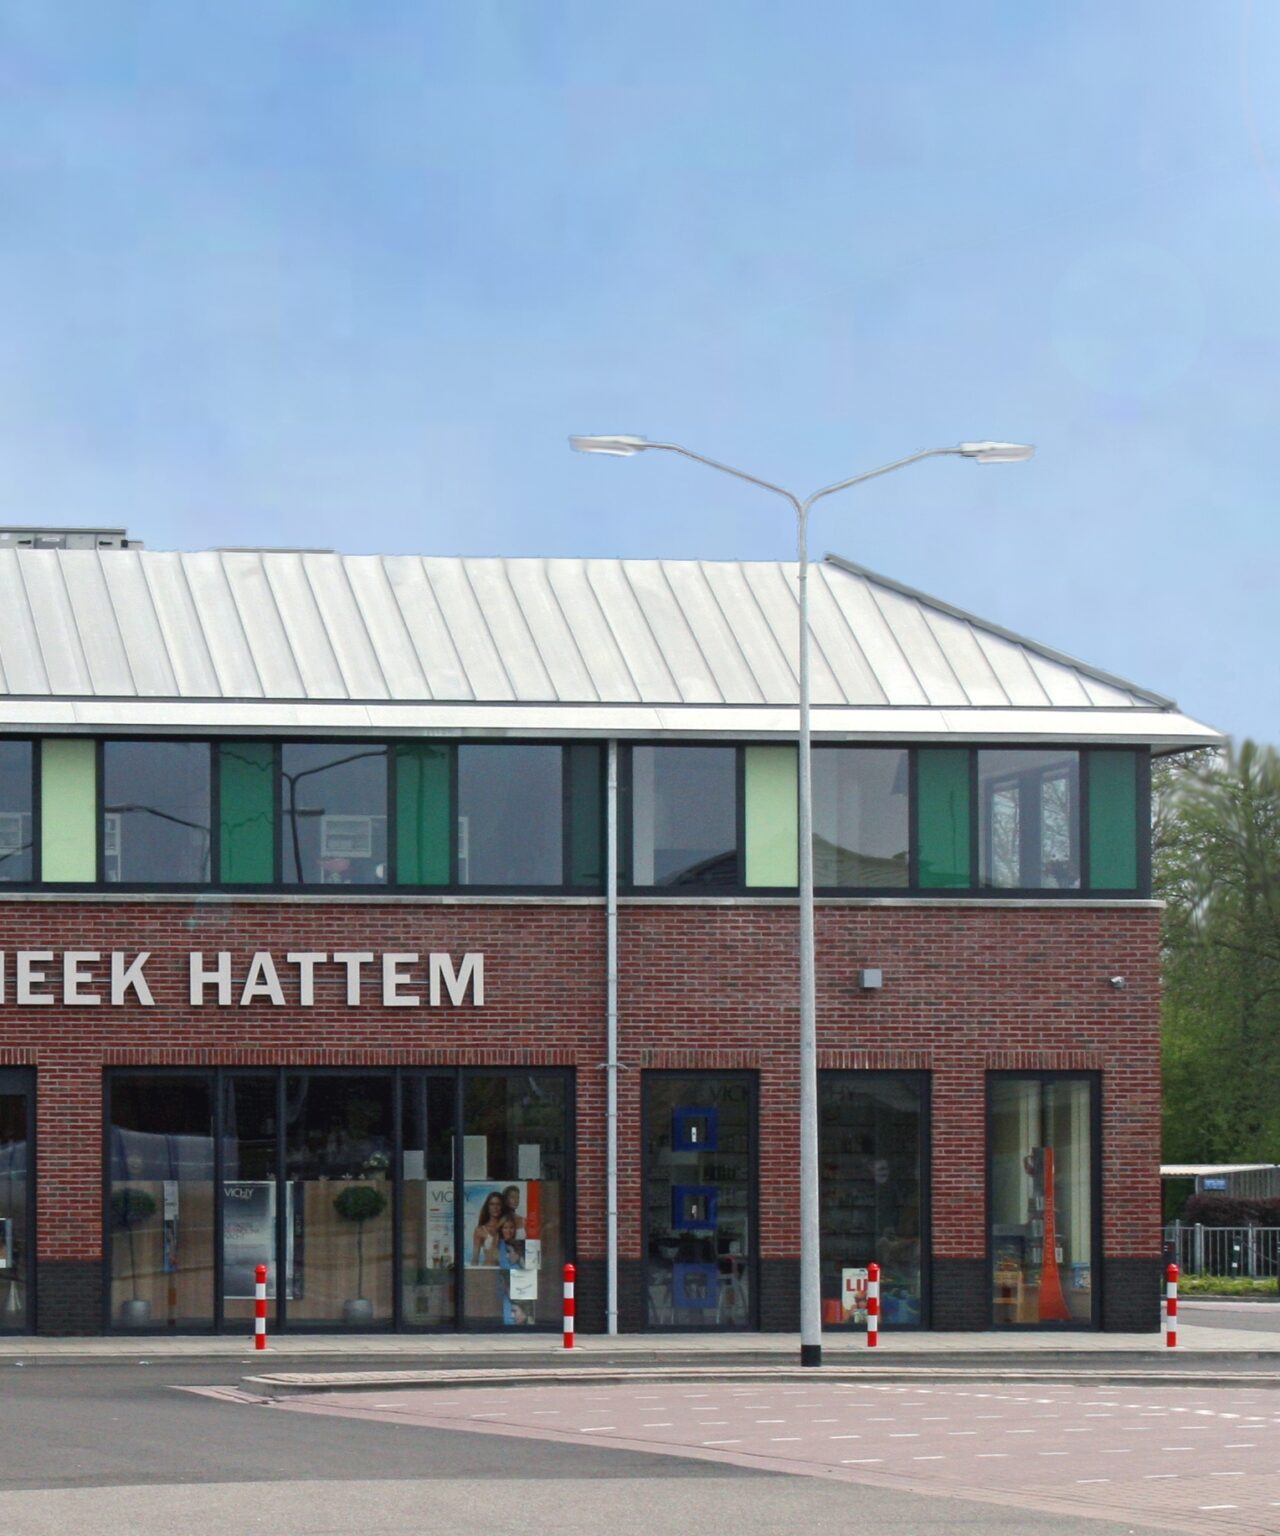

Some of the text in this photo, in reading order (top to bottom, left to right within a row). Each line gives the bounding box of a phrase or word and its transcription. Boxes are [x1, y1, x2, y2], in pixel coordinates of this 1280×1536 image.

[189, 951, 485, 1007] HATTEM
[224, 1187, 255, 1199] VICHY
[431, 1190, 472, 1203] VICY
